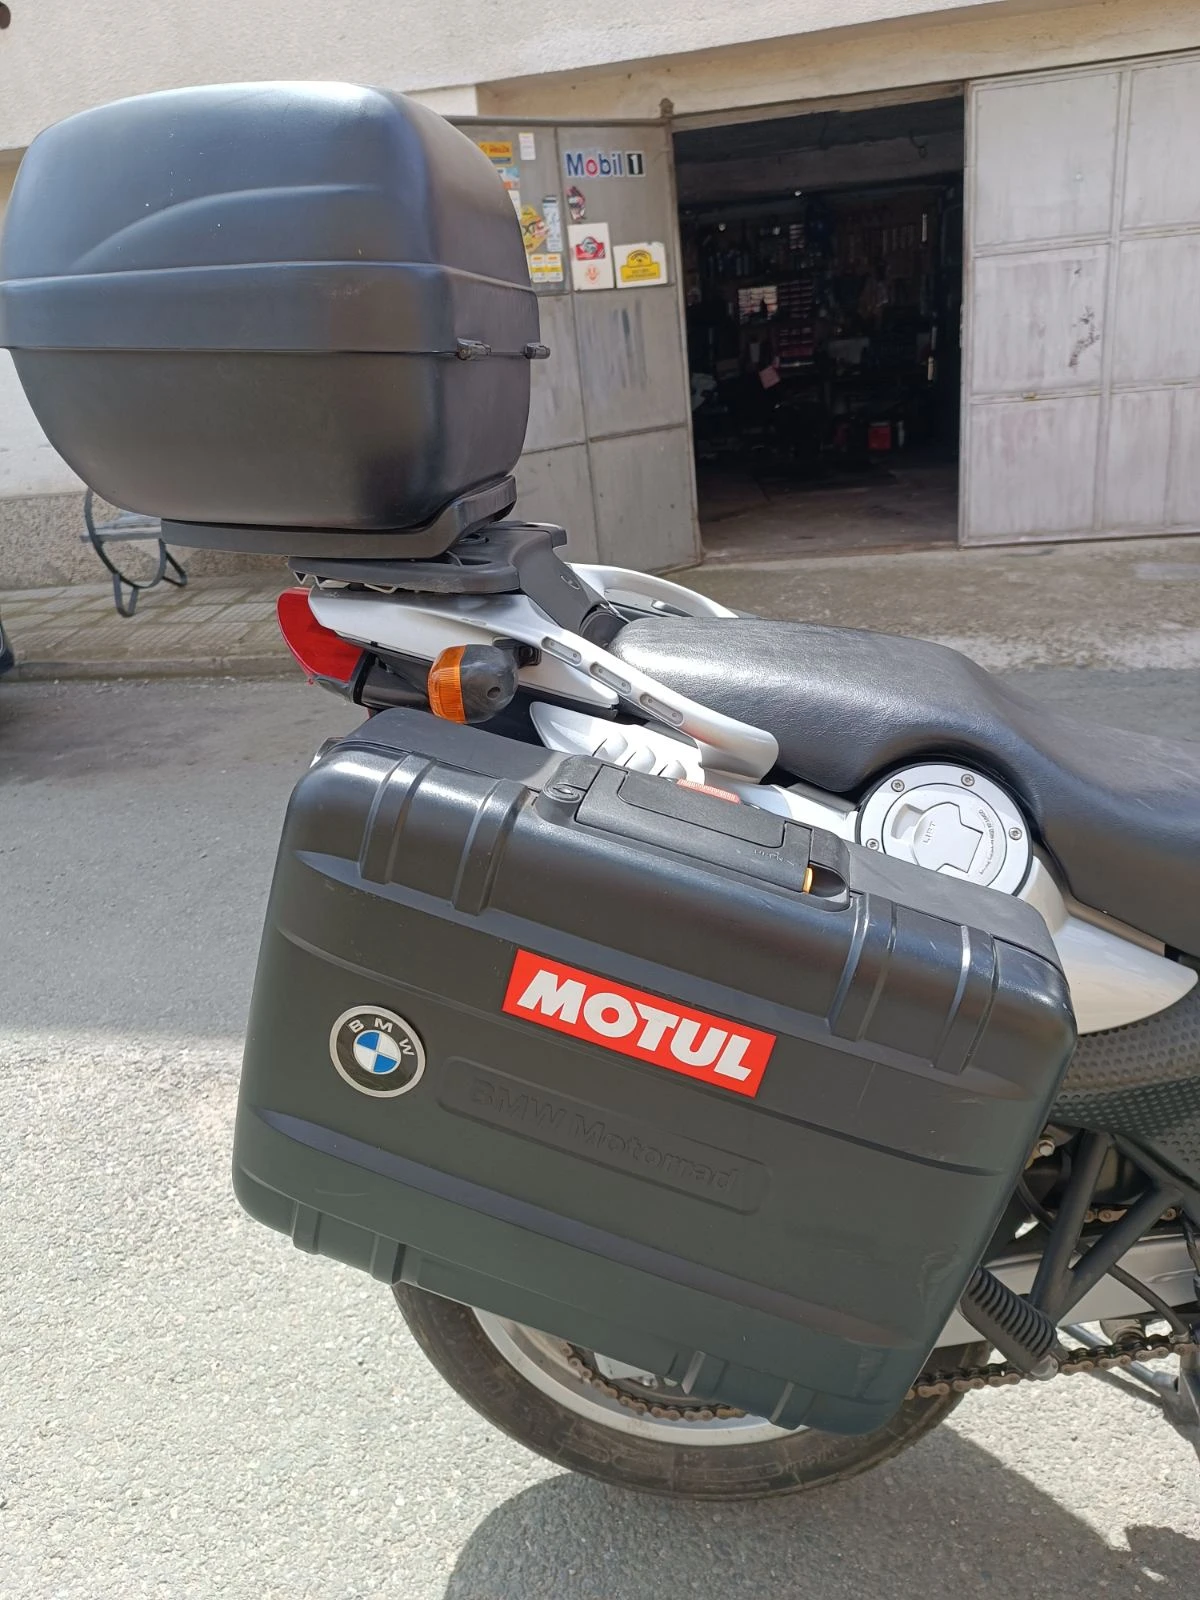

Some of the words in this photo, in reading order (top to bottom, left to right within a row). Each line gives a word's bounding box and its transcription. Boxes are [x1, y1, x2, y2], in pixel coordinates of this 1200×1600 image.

[566, 153, 623, 177] Mobil
[627, 153, 644, 176] 1
[348, 1017, 415, 1057] BMW
[517, 969, 752, 1082] MOTUL
[470, 1080, 567, 1132] BMW
[575, 1113, 740, 1193] Motorrad
